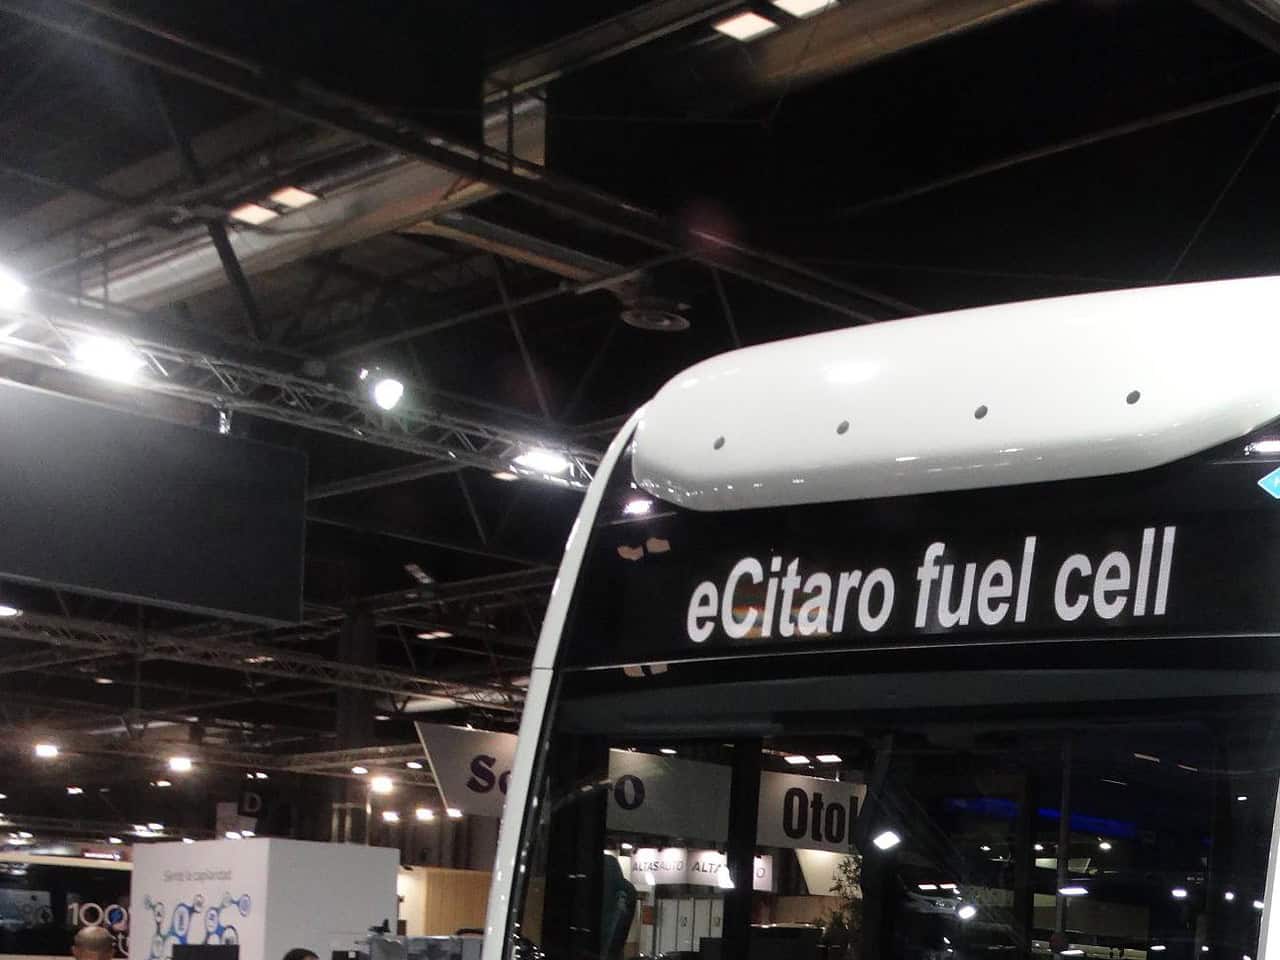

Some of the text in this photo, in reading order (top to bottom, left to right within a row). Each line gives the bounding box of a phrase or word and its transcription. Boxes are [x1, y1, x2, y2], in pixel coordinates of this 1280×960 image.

[687, 526, 1177, 643] eCitaro fuel cell
